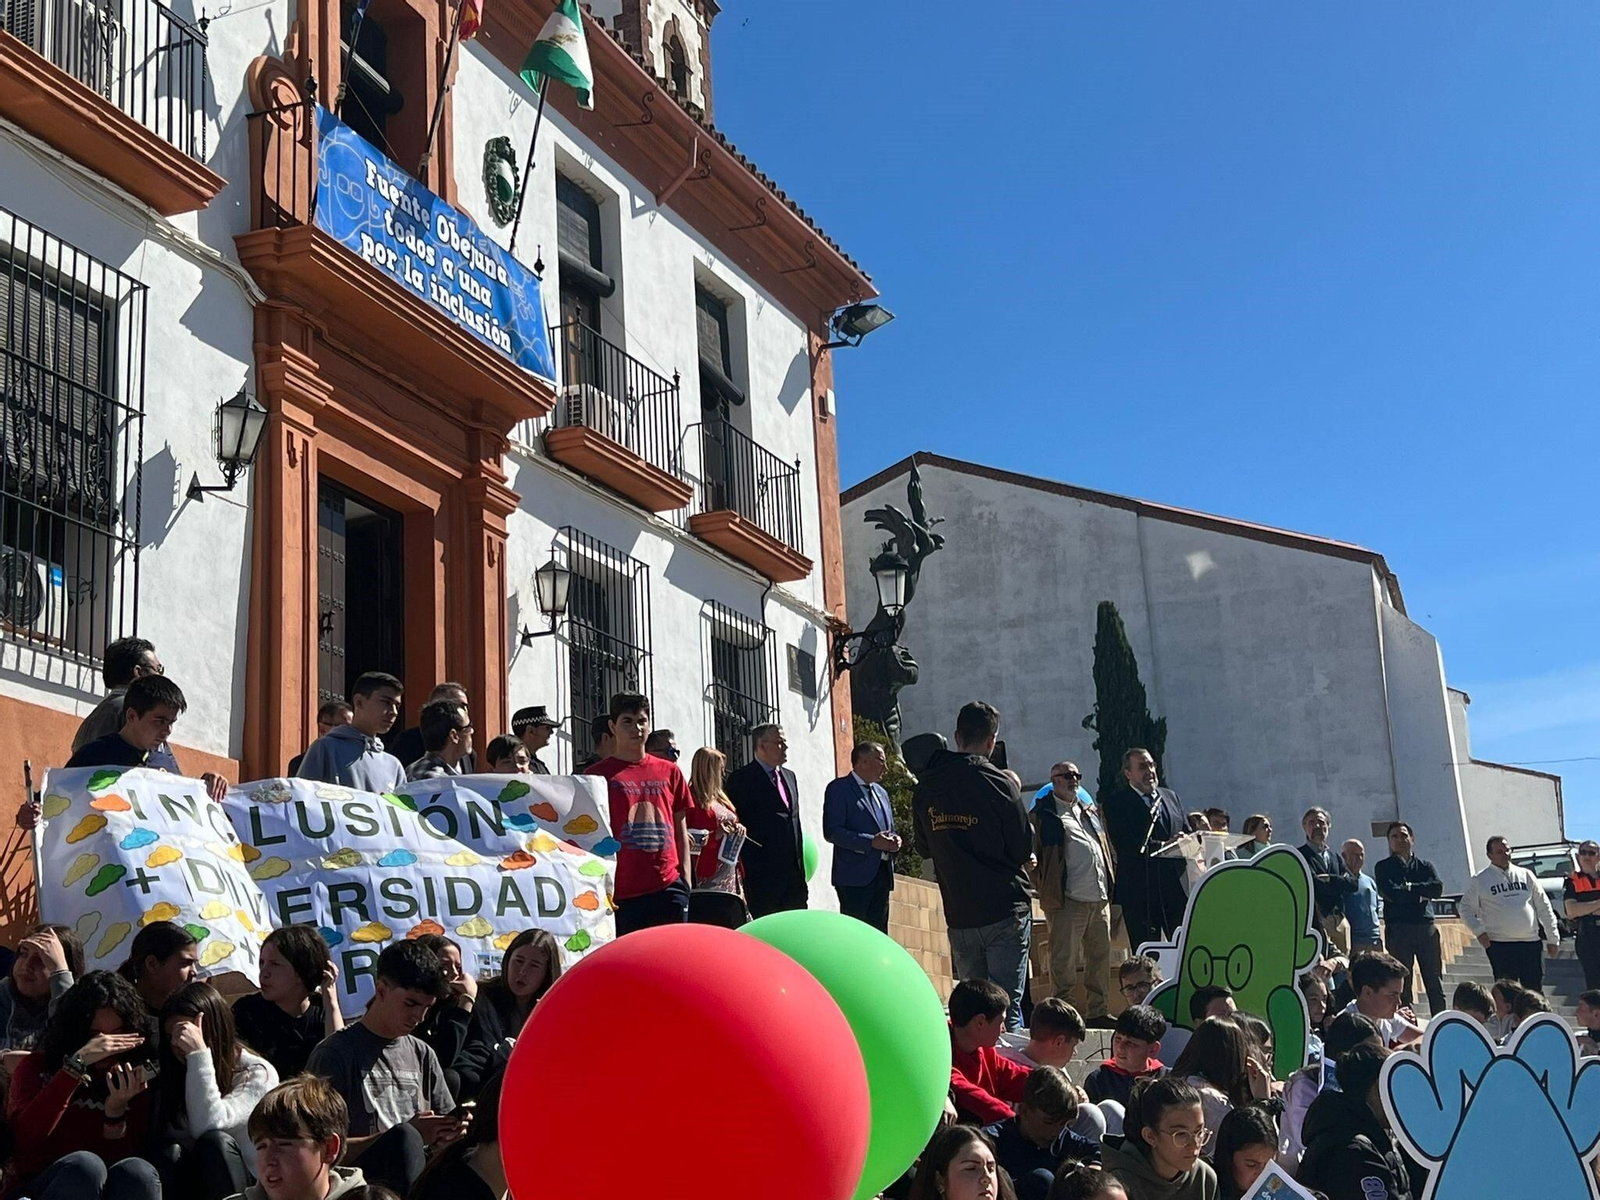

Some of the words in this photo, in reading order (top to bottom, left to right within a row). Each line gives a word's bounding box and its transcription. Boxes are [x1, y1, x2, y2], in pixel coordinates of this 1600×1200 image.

[365, 158, 431, 229] Fuente
[437, 213, 509, 287] Obejuna
[384, 209, 436, 267] todos
[441, 258, 455, 280] a
[458, 273, 493, 309] una
[360, 232, 398, 272] por
[404, 252, 425, 293] la
[430, 276, 512, 354] inclusión
[126, 788, 507, 847] INCLUSIÓN
